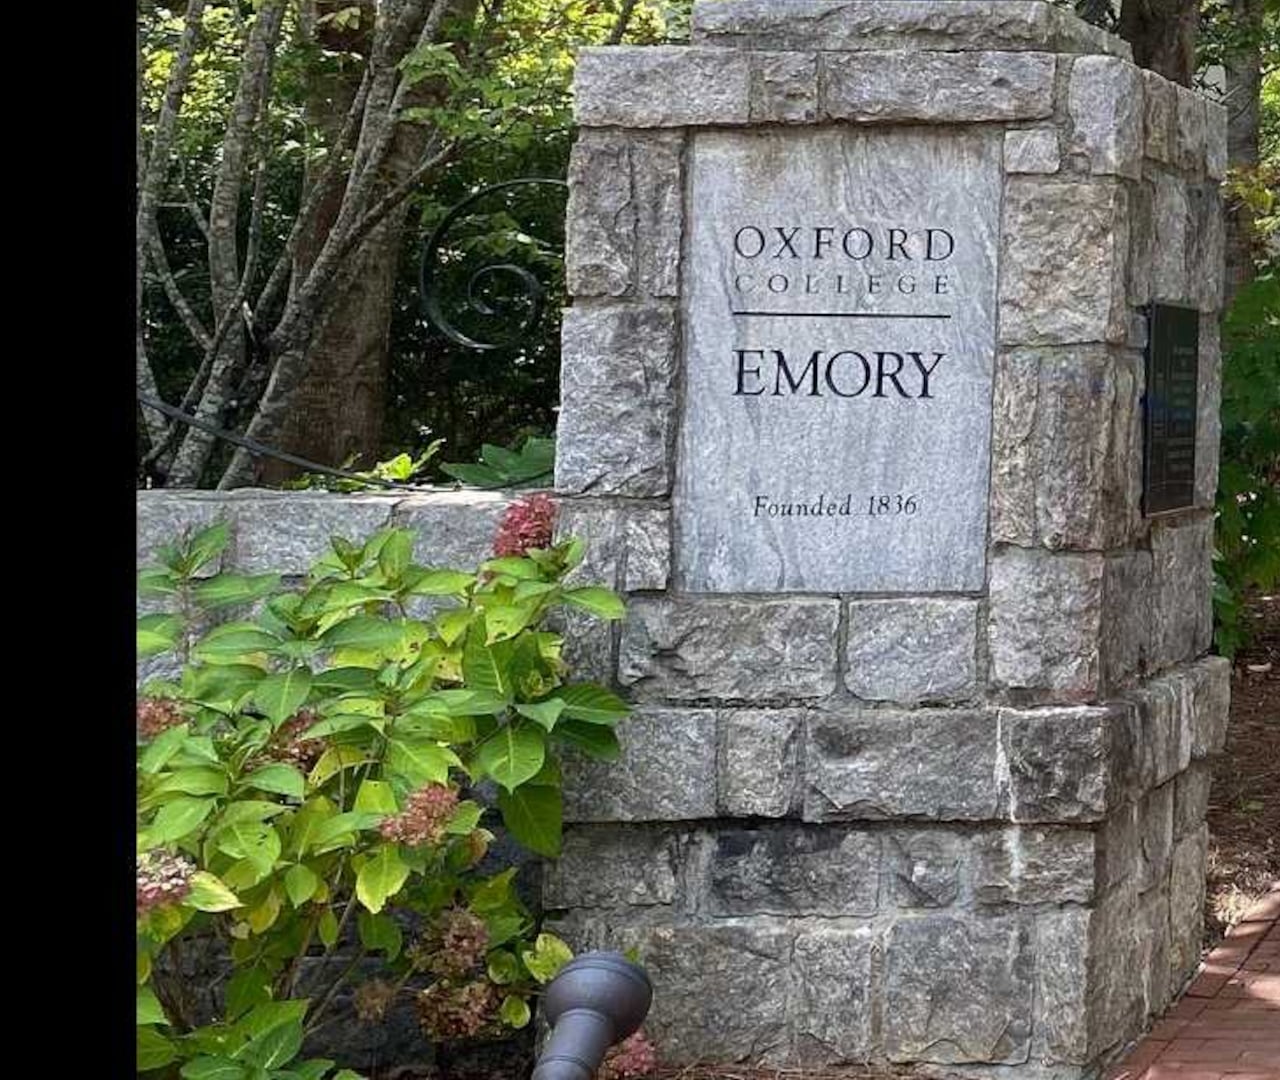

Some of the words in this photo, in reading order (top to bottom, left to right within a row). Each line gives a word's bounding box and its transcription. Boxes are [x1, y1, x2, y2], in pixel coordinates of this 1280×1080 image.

[734, 225, 955, 261] OXFORD
[735, 274, 951, 294] COLLEGE
[733, 350, 946, 399] EMORY
[753, 495, 852, 518] Founded
[867, 494, 919, 516] 1836
